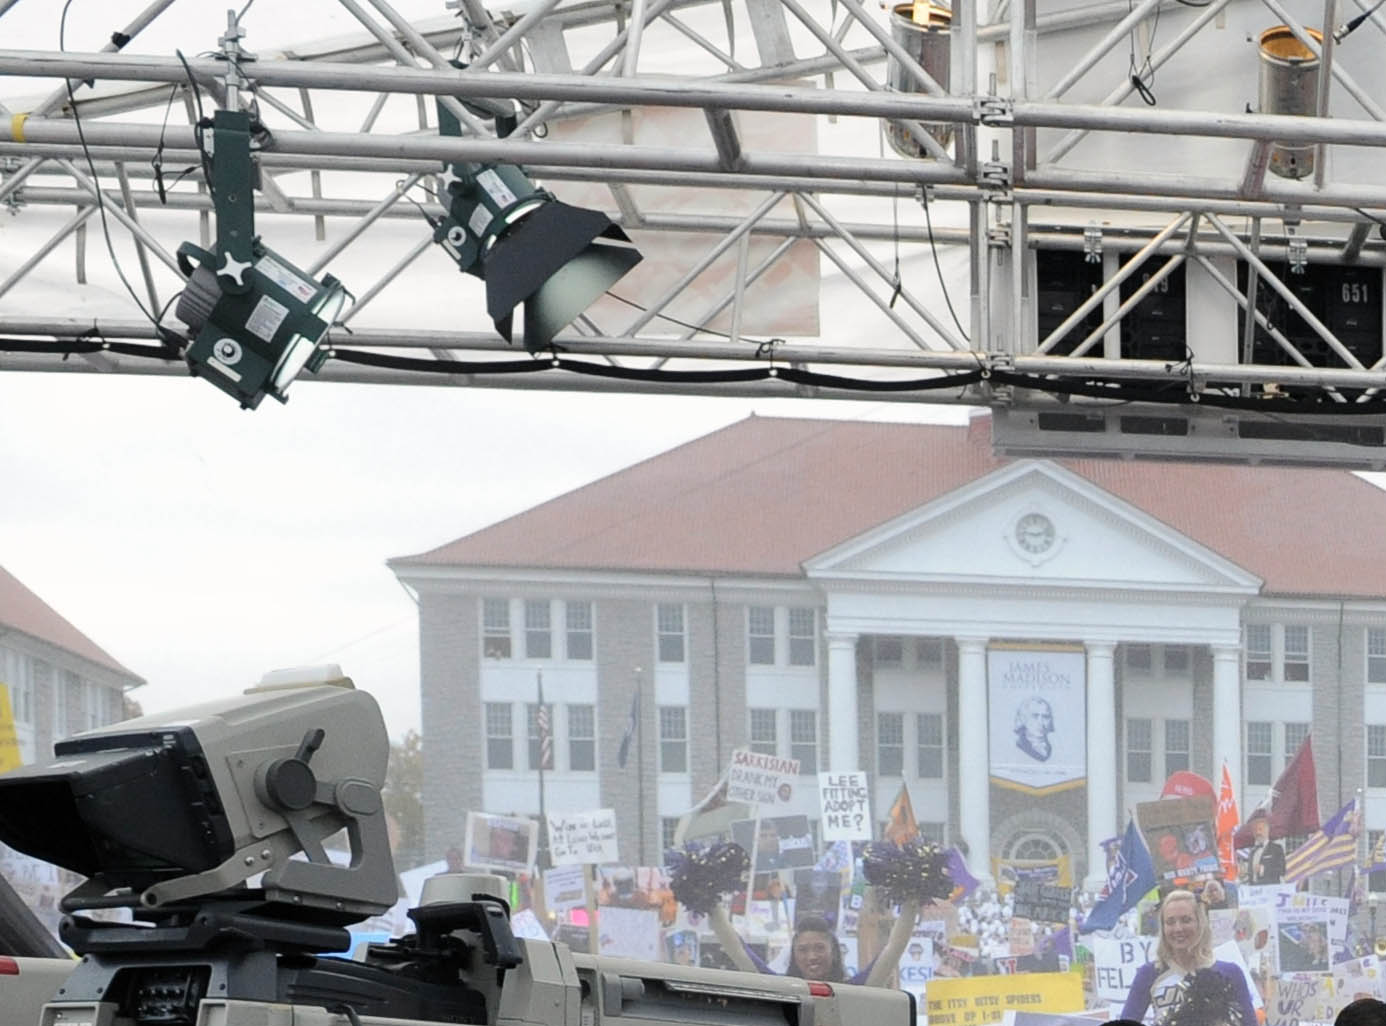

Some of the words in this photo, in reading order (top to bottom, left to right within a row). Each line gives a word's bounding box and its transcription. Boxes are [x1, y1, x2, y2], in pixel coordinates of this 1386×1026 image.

[1341, 283, 1369, 303] 651
[1008, 661, 1051, 673] JAMES
[1002, 672, 1071, 685] MADISON
[735, 751, 799, 775] SARKISIAN
[828, 775, 859, 787] LEE
[822, 787, 867, 799] FITTING
[824, 800, 865, 813] ADOPT
[828, 814, 864, 832] ME?
[1097, 967, 1130, 989] FEL
[1277, 1000, 1304, 1016] UR
